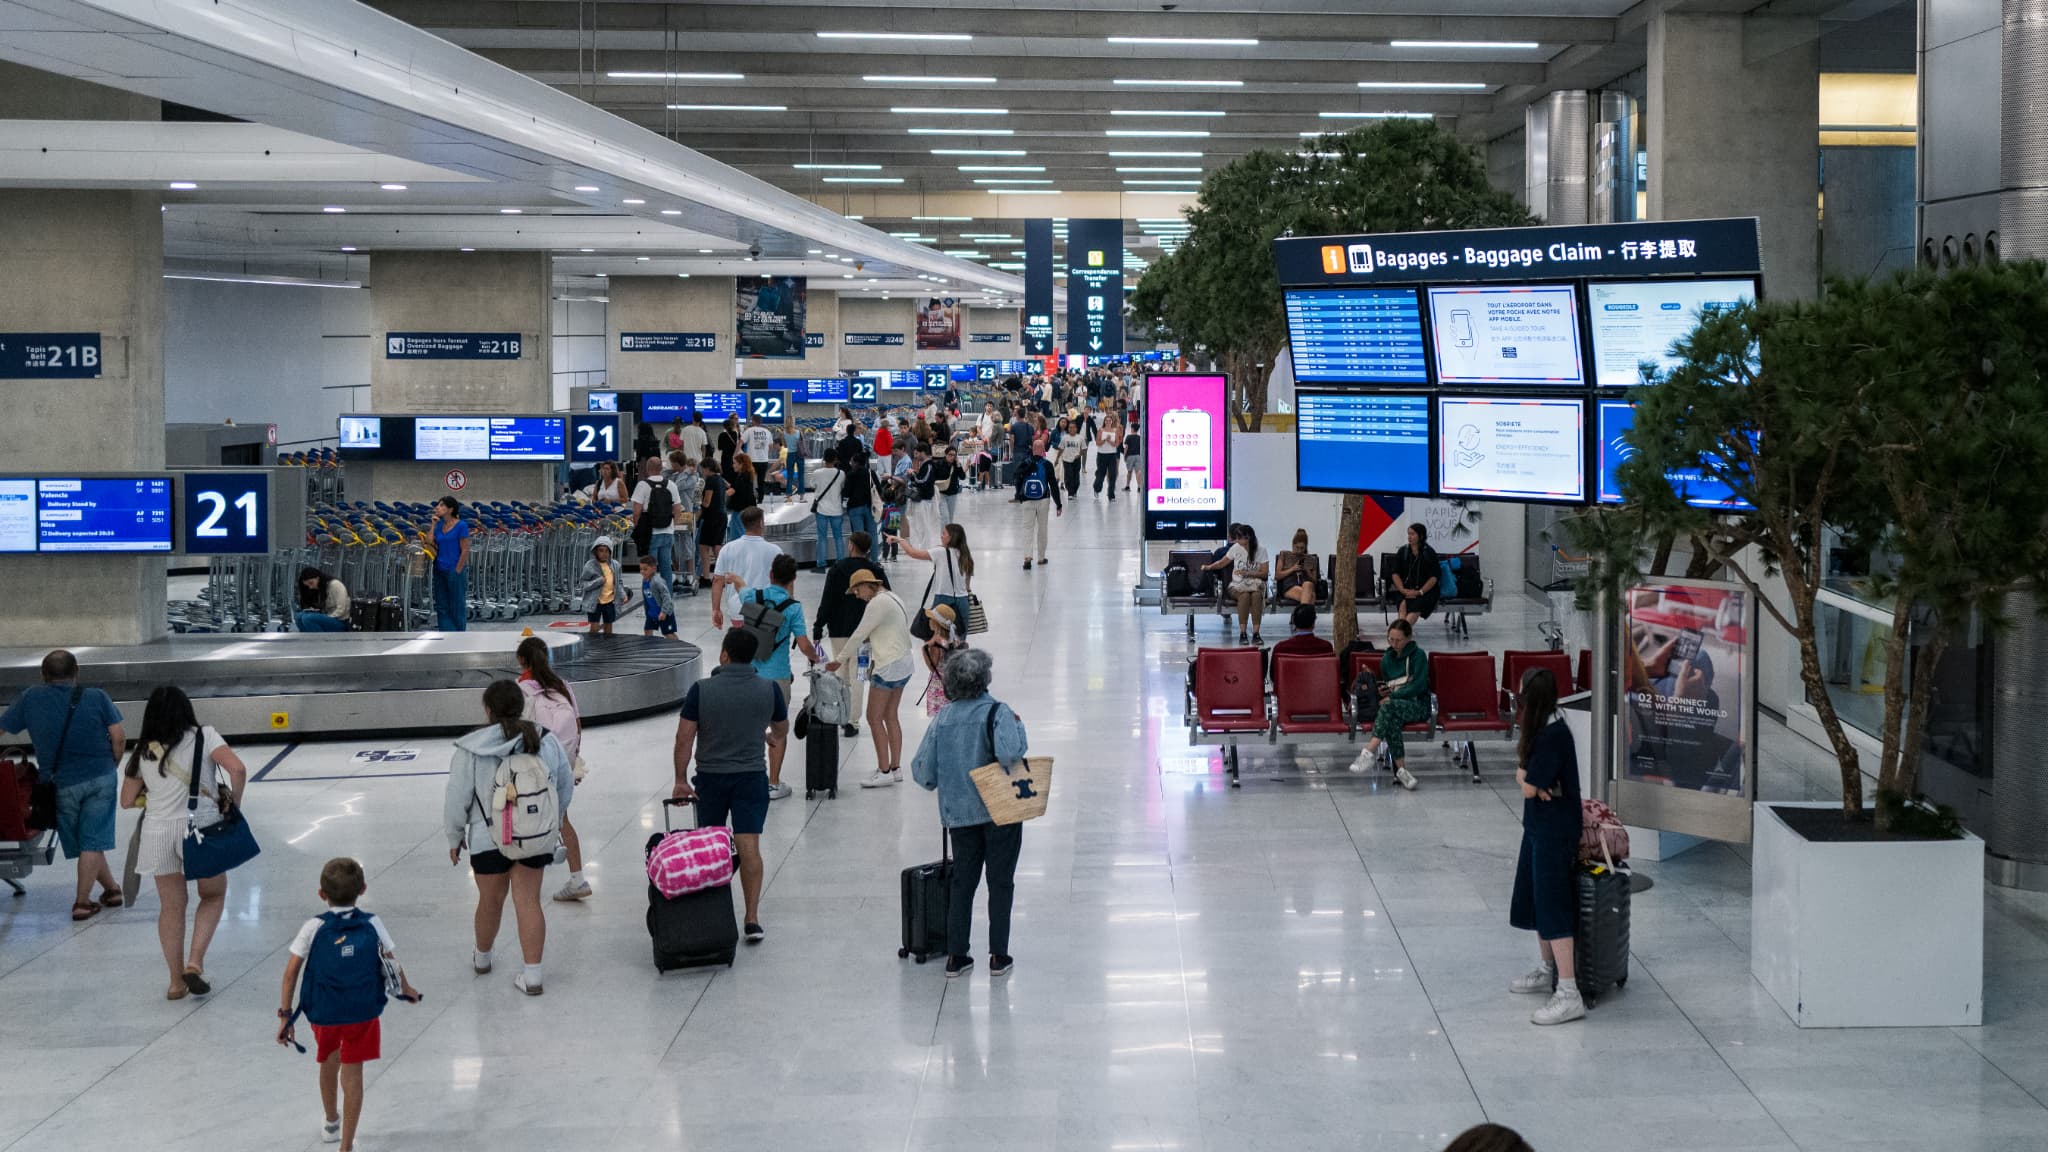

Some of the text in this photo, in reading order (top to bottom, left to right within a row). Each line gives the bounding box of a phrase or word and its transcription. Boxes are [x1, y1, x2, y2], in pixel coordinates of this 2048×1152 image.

[1376, 250, 1448, 270] Bagages
[1464, 246, 1544, 268] Baggage
[1549, 242, 1602, 260] Claim
[1620, 240, 1697, 260] 行李提取
[491, 341, 520, 353] 21B
[694, 338, 714, 347] 21B
[808, 337, 823, 345] 21B
[48, 346, 98, 367] 21B
[1088, 356, 1100, 365] 24
[979, 367, 995, 379] 23
[1027, 363, 1041, 373] 24
[927, 374, 946, 387] 23
[852, 384, 874, 399] 22
[753, 398, 782, 417] 22
[577, 425, 615, 452] 21
[196, 492, 257, 537] 21
[1425, 507, 1457, 518] PARIS
[1638, 693, 1652, 703] 02
[1668, 696, 1707, 707] CONNECT
[1655, 702, 1728, 718] WITH THE WORLD
